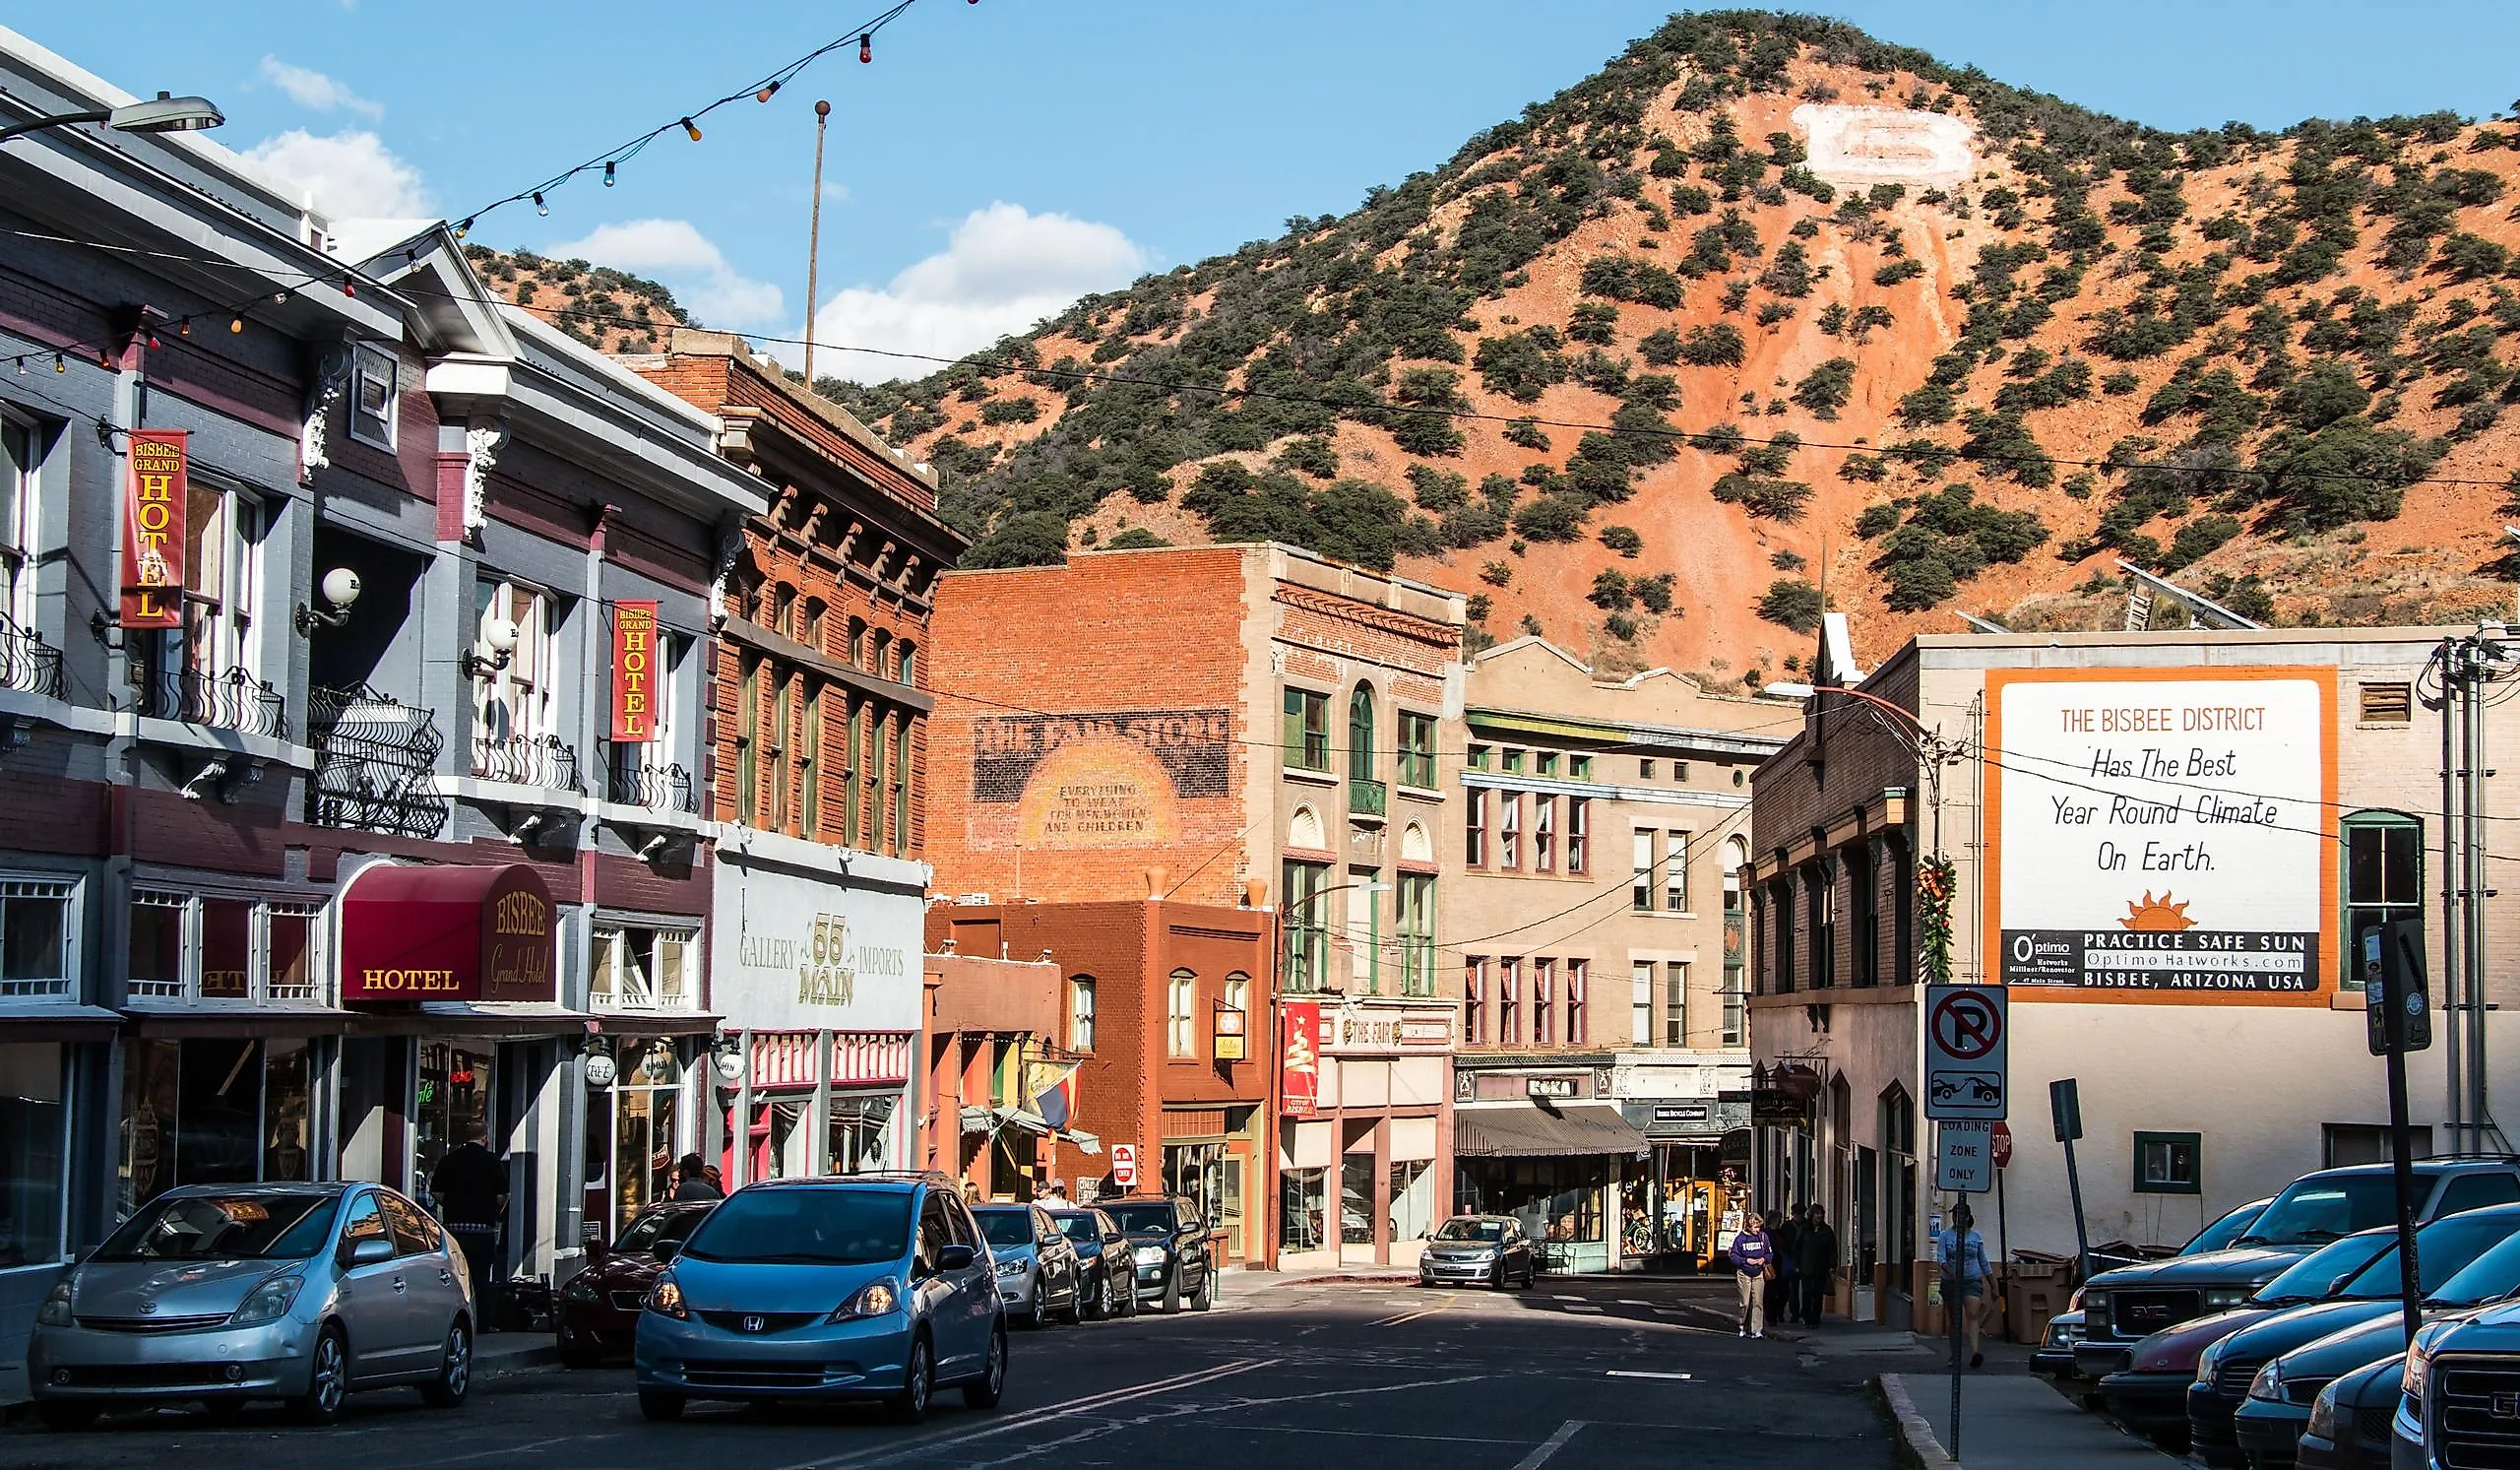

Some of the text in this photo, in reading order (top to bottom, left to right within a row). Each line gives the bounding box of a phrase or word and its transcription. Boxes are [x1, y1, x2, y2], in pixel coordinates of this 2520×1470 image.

[134, 442, 180, 459] BISBEE
[134, 458, 180, 473] GRAND
[136, 474, 173, 617] HOTEL
[619, 608, 653, 620] BISBEE
[619, 620, 652, 630] GRAND
[623, 631, 648, 735] HOTEL
[2061, 707, 2266, 733] THE BISBEE DISTRICT
[2091, 747, 2236, 778] Has The Best
[1059, 785, 1136, 797] EVERYTHING
[1063, 798, 1125, 807] TO WEAR
[2051, 795, 2278, 825] Year Round Climate
[1043, 820, 1143, 835] AND CHILDREN
[2098, 842, 2216, 871] On Earth.
[495, 890, 545, 936] BISBEE
[2084, 933, 2305, 951] PRACTICE SAFE SUN
[739, 934, 797, 970] GALLERY
[858, 945, 905, 977] IMPORTS
[2087, 952, 2158, 969] Optimo
[490, 943, 549, 993] Grand Hotel
[362, 969, 460, 991] HOTEL
[798, 963, 855, 1007] MAIN
[2084, 972, 2304, 990] BISBEE, ARIZONA USA
[1352, 1021, 1390, 1044] THE FAIR
[586, 1063, 611, 1078] CAFÉ
[1941, 1120, 1989, 1132] LOADING
[1950, 1144, 1978, 1158] ZONE
[1992, 1134, 2011, 1153] STOP
[1949, 1168, 1975, 1181] ONLY
